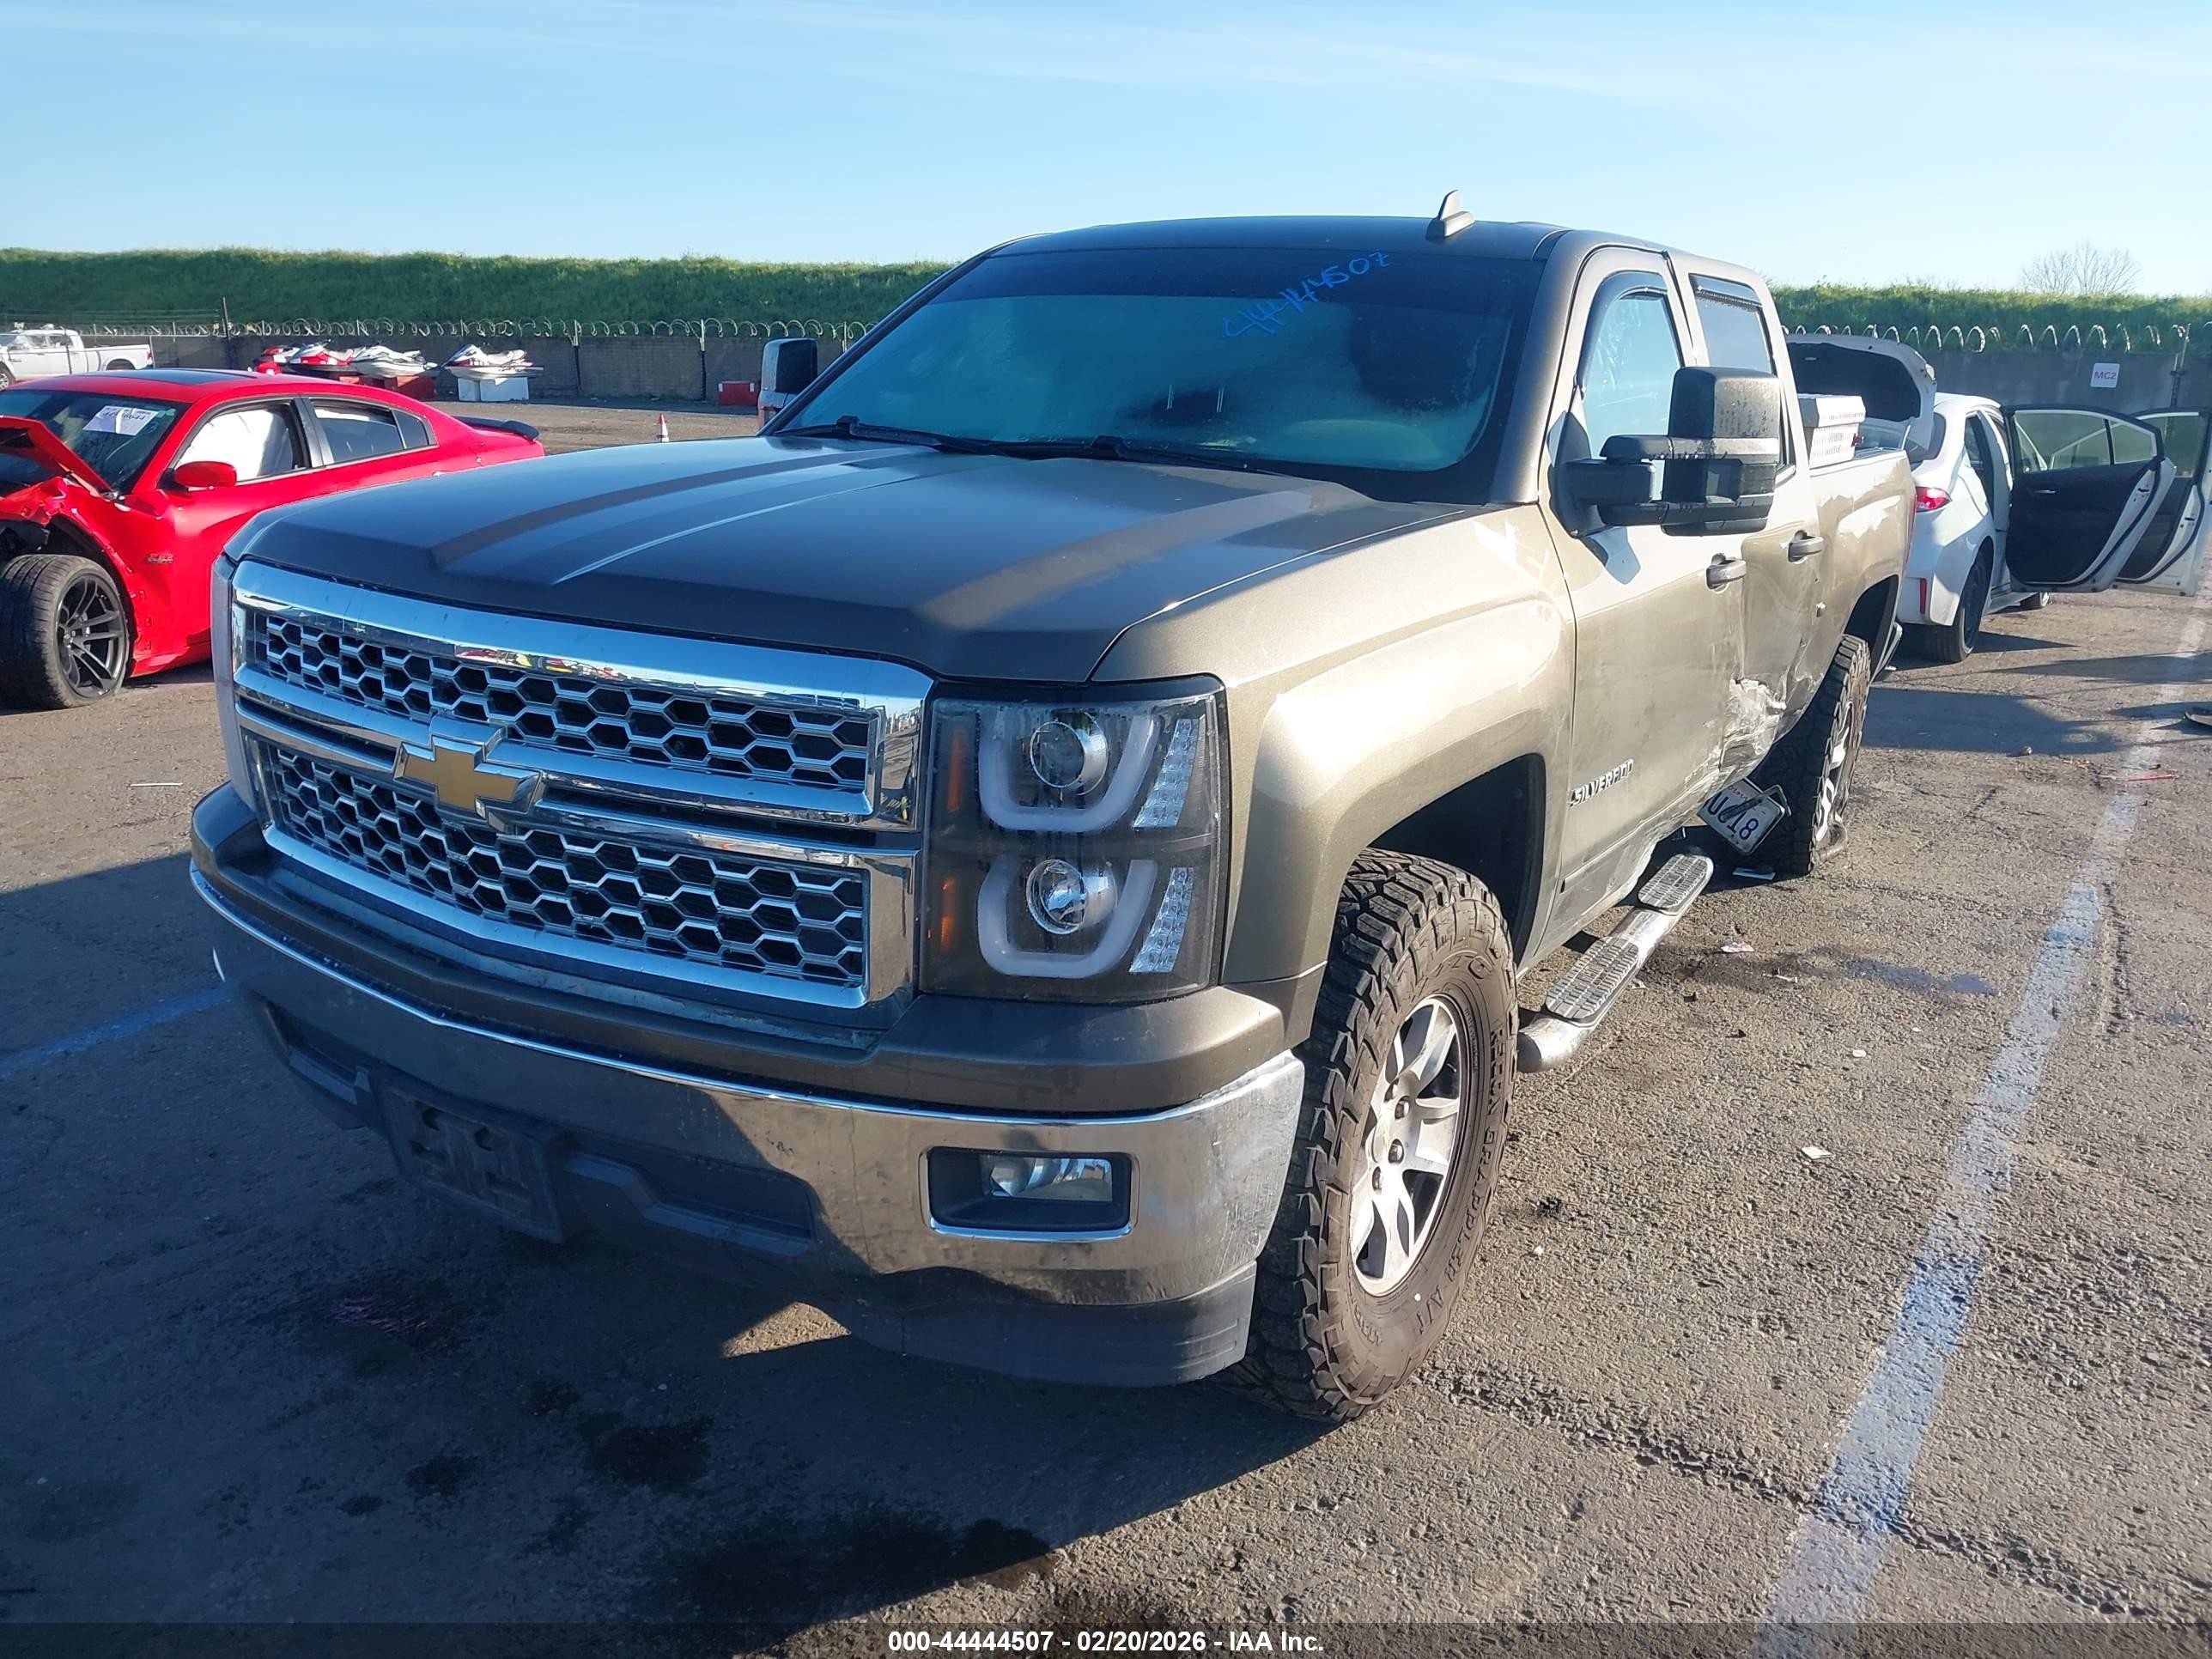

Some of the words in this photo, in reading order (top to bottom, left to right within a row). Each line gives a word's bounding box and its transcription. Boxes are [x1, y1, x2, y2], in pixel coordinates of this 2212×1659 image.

[2094, 371, 2116, 380] MC2
[1570, 758, 1634, 807] SILVERADO
[1443, 1126, 1496, 1283] GRAPPLER
